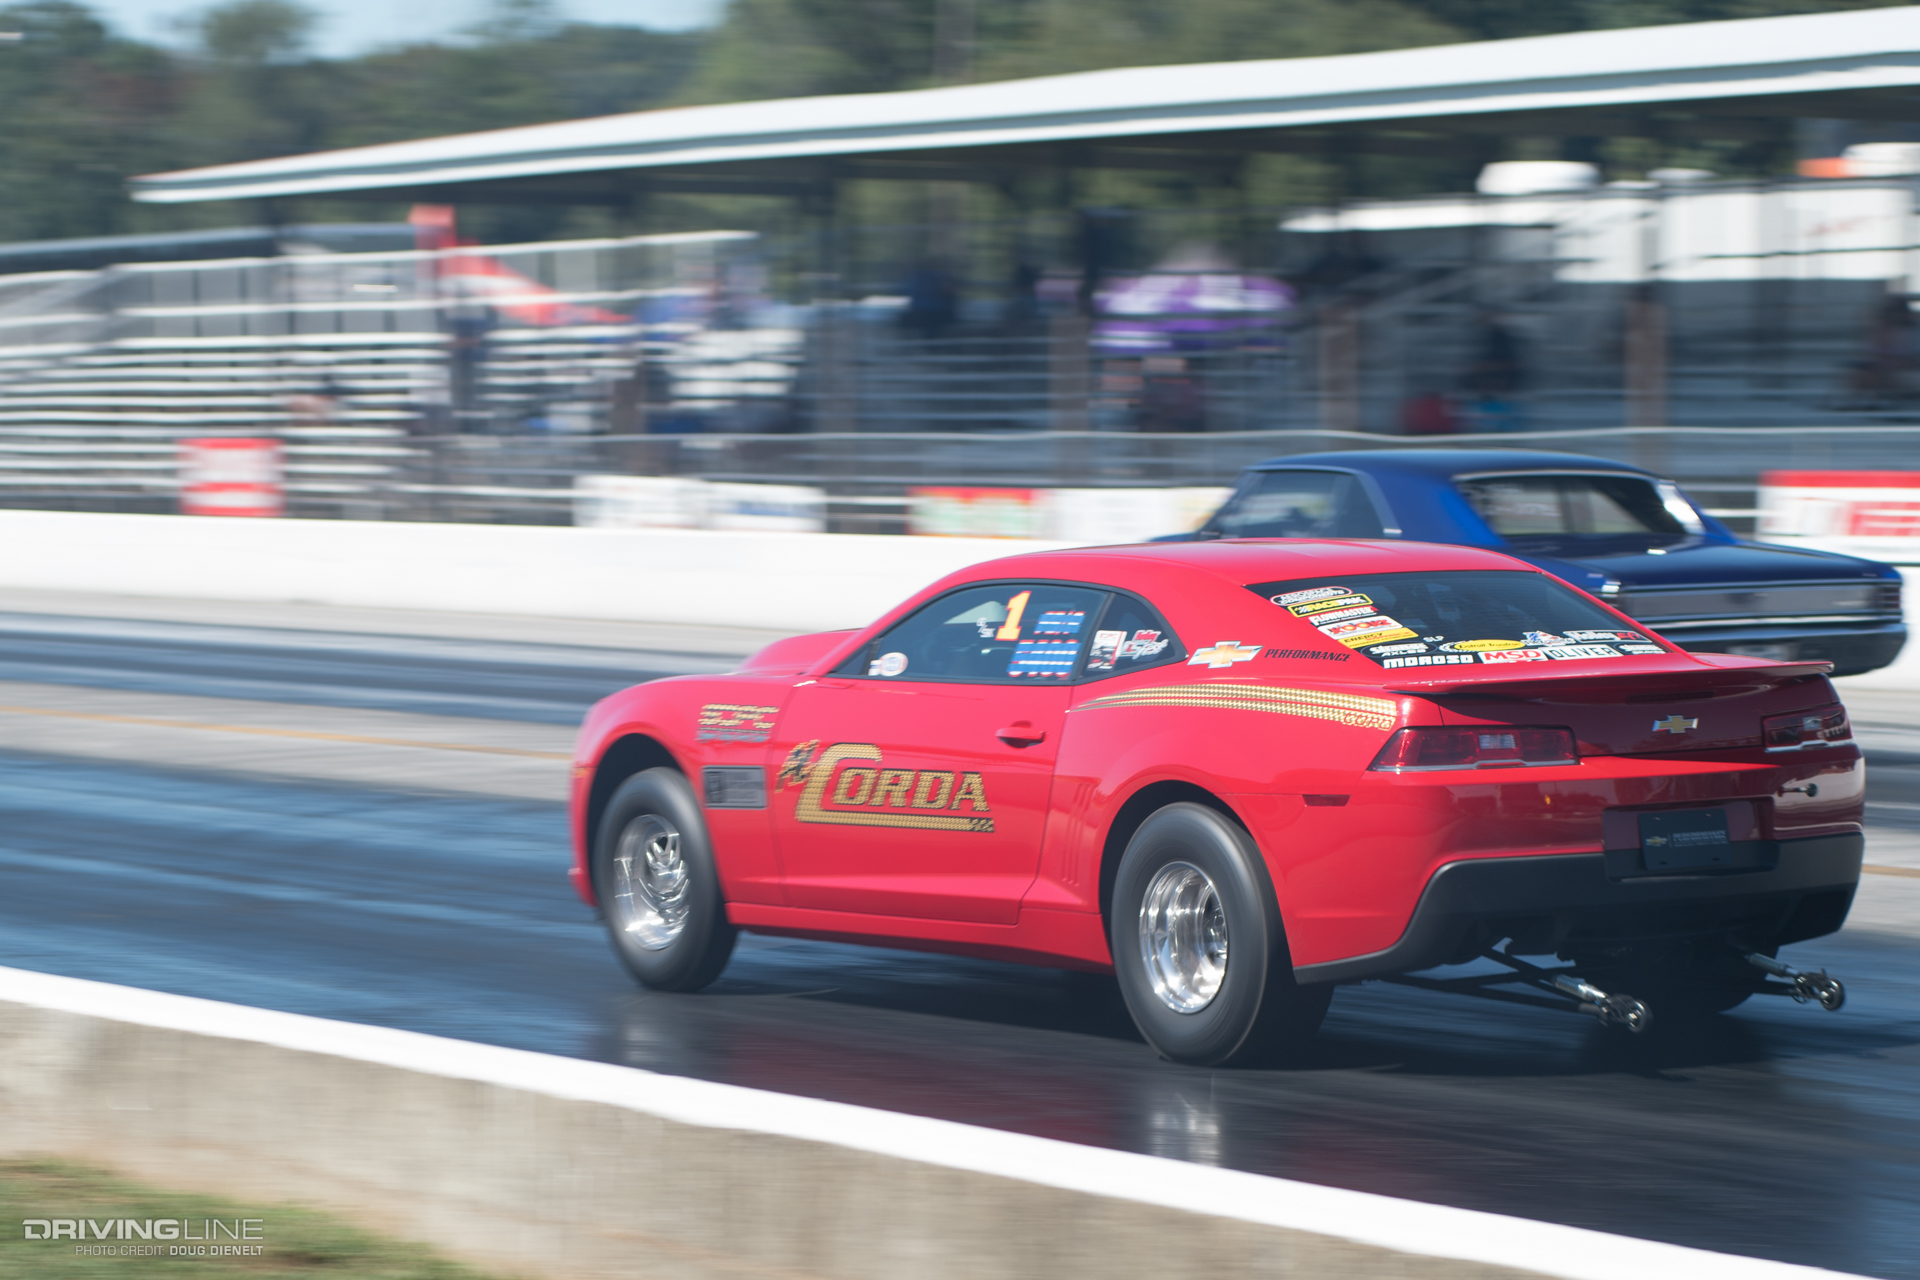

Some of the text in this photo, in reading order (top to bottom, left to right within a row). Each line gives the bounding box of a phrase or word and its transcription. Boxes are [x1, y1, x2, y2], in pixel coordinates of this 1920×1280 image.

[995, 590, 1032, 641] 1
[1308, 605, 1375, 626] FLOWMASTER
[1264, 648, 1352, 662] PERFORMANCE
[1484, 650, 1542, 661] MSD
[1550, 646, 1619, 658] OLIVER
[1383, 654, 1474, 669] MOROSO
